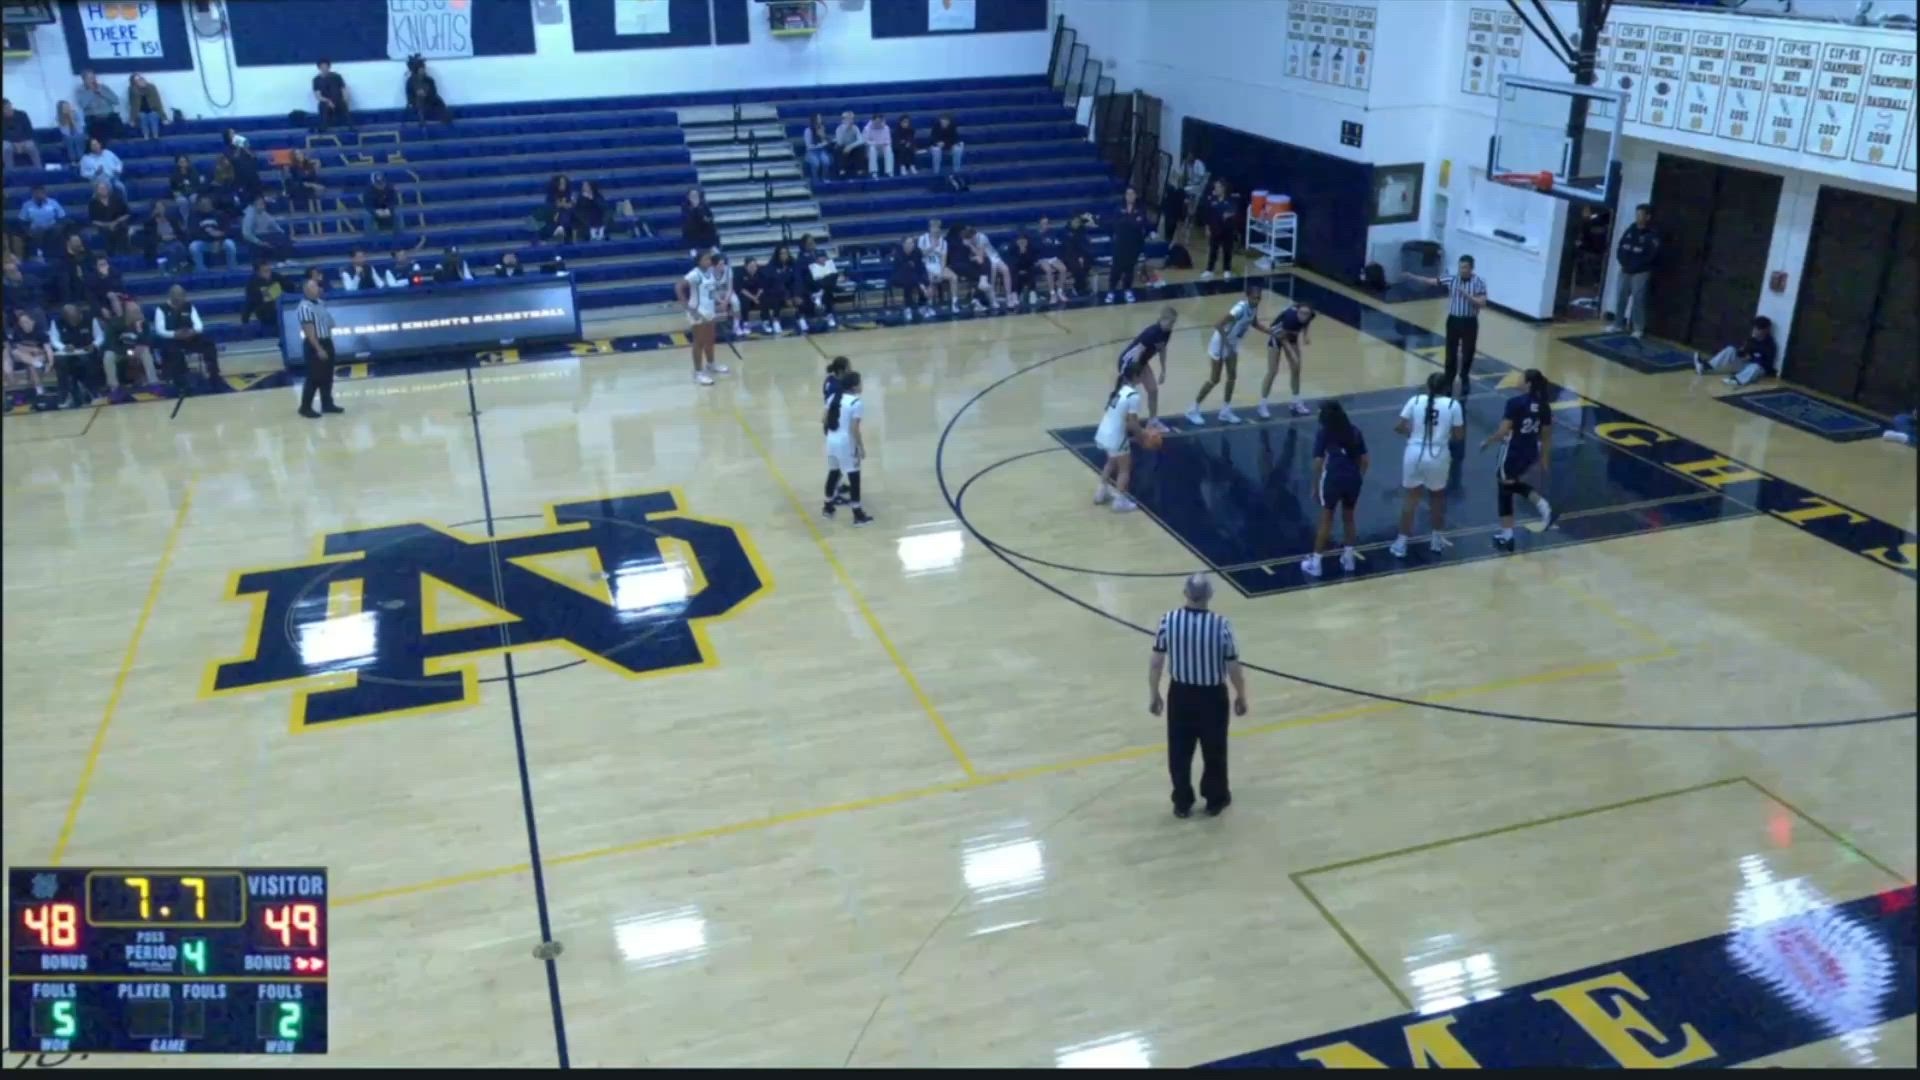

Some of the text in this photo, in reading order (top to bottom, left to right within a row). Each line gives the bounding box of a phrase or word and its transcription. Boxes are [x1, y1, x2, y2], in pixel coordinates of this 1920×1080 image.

[87, 24, 138, 41] THERE
[110, 41, 160, 56] IT IS!
[1818, 124, 1841, 136] 2007
[401, 316, 470, 330] KNIGHTS
[473, 308, 565, 323] BASKETBALL
